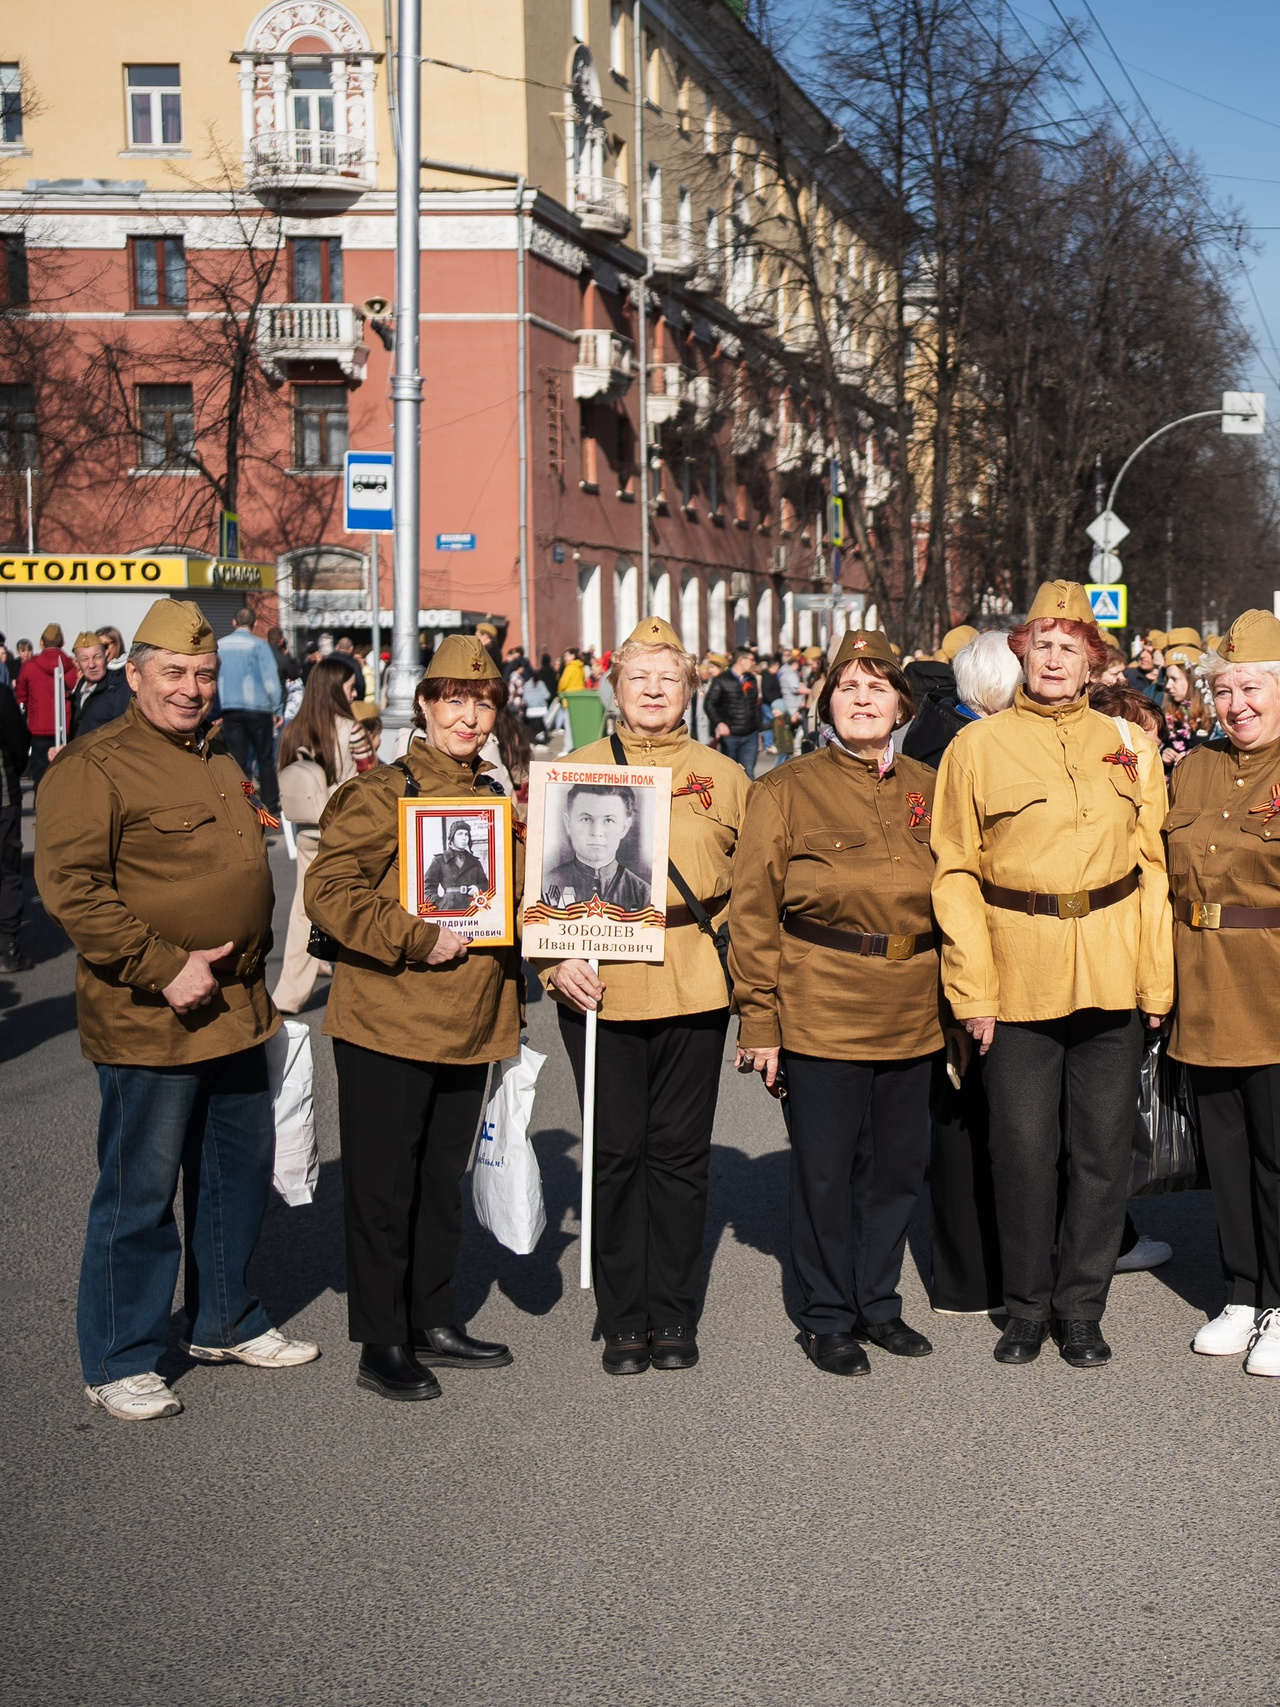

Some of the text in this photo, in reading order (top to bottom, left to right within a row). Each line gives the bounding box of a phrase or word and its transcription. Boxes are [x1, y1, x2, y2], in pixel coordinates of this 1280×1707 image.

[0, 560, 162, 581] СТОЛОТО
[561, 771, 655, 786] БЕССМЕРТНЫЙ ПОЛК
[436, 919, 479, 928] Подругин
[557, 923, 635, 938] ЗОБОЛЕВ
[538, 937, 654, 954] Иван Павлович
